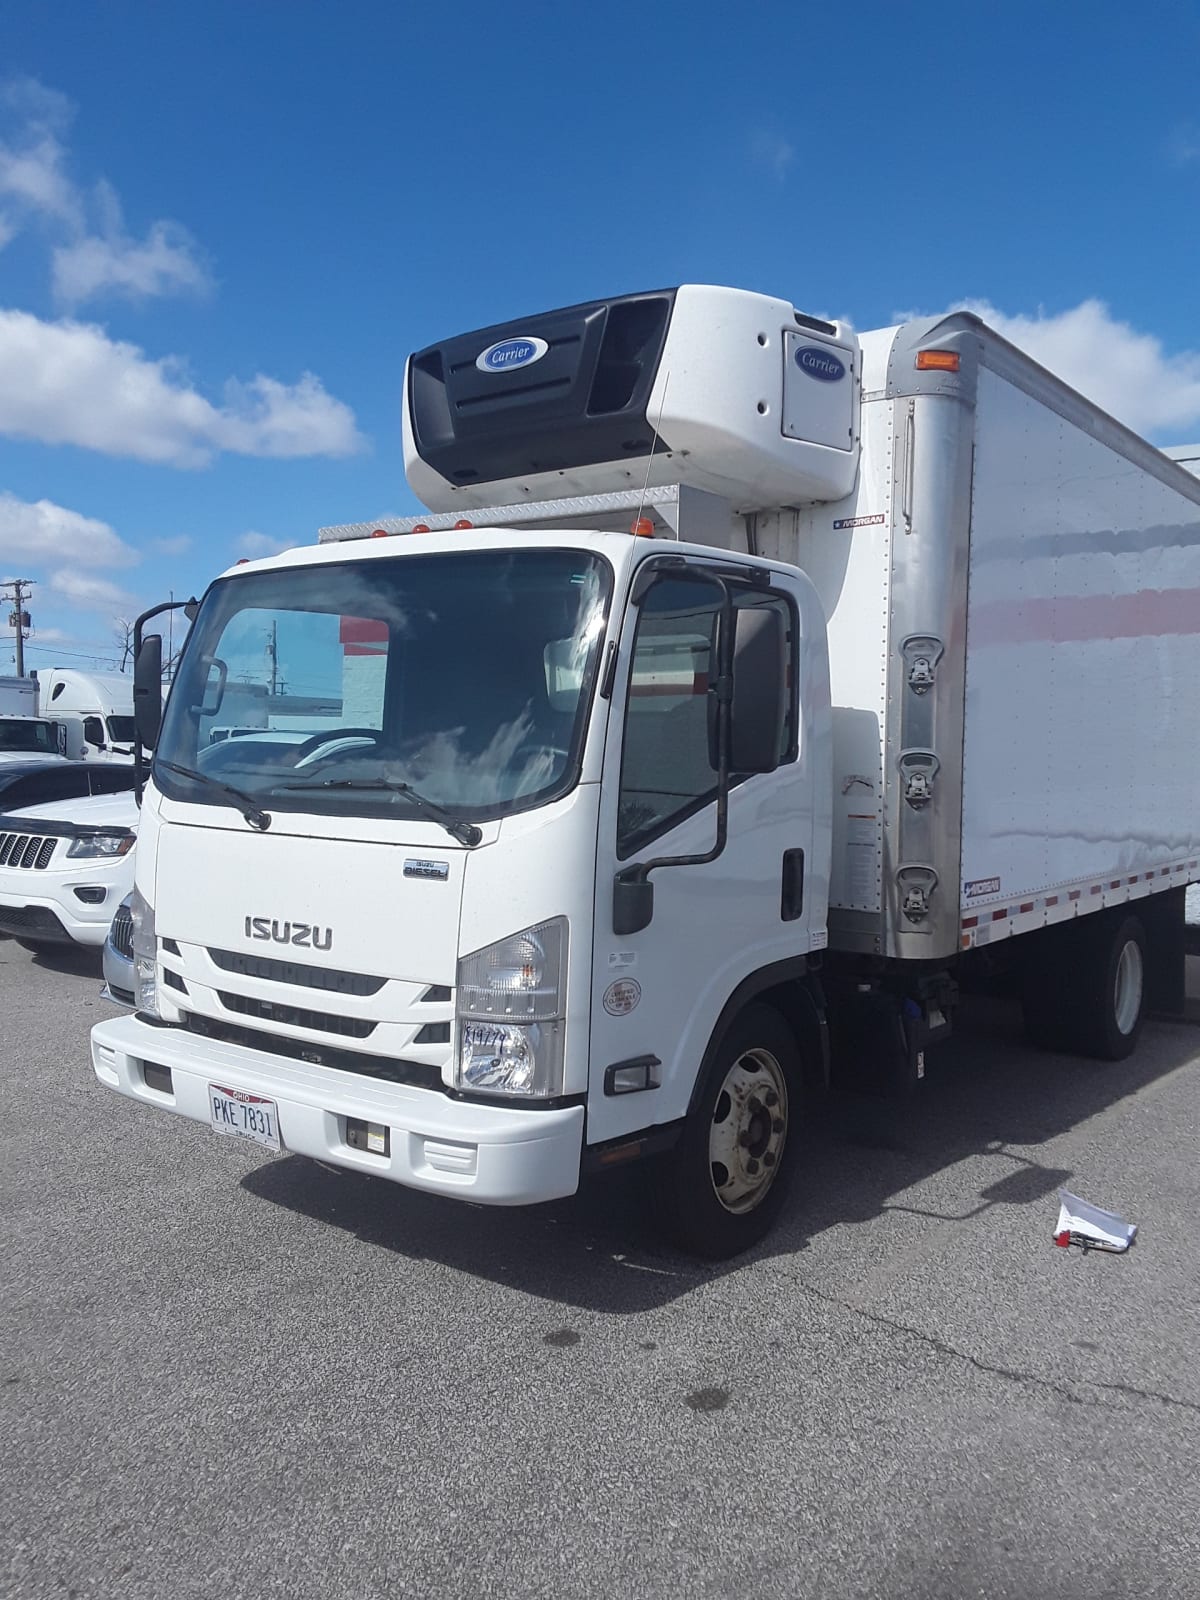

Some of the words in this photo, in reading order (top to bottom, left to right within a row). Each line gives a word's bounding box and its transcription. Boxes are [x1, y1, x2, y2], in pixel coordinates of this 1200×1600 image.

[491, 347, 531, 363] Carrier
[802, 352, 840, 375] Carrier
[842, 516, 884, 528] MORGAN
[245, 916, 333, 951] ISUZU
[233, 1091, 250, 1102] OHIO
[213, 1096, 239, 1127] PKE
[240, 1104, 273, 1137] 7831
